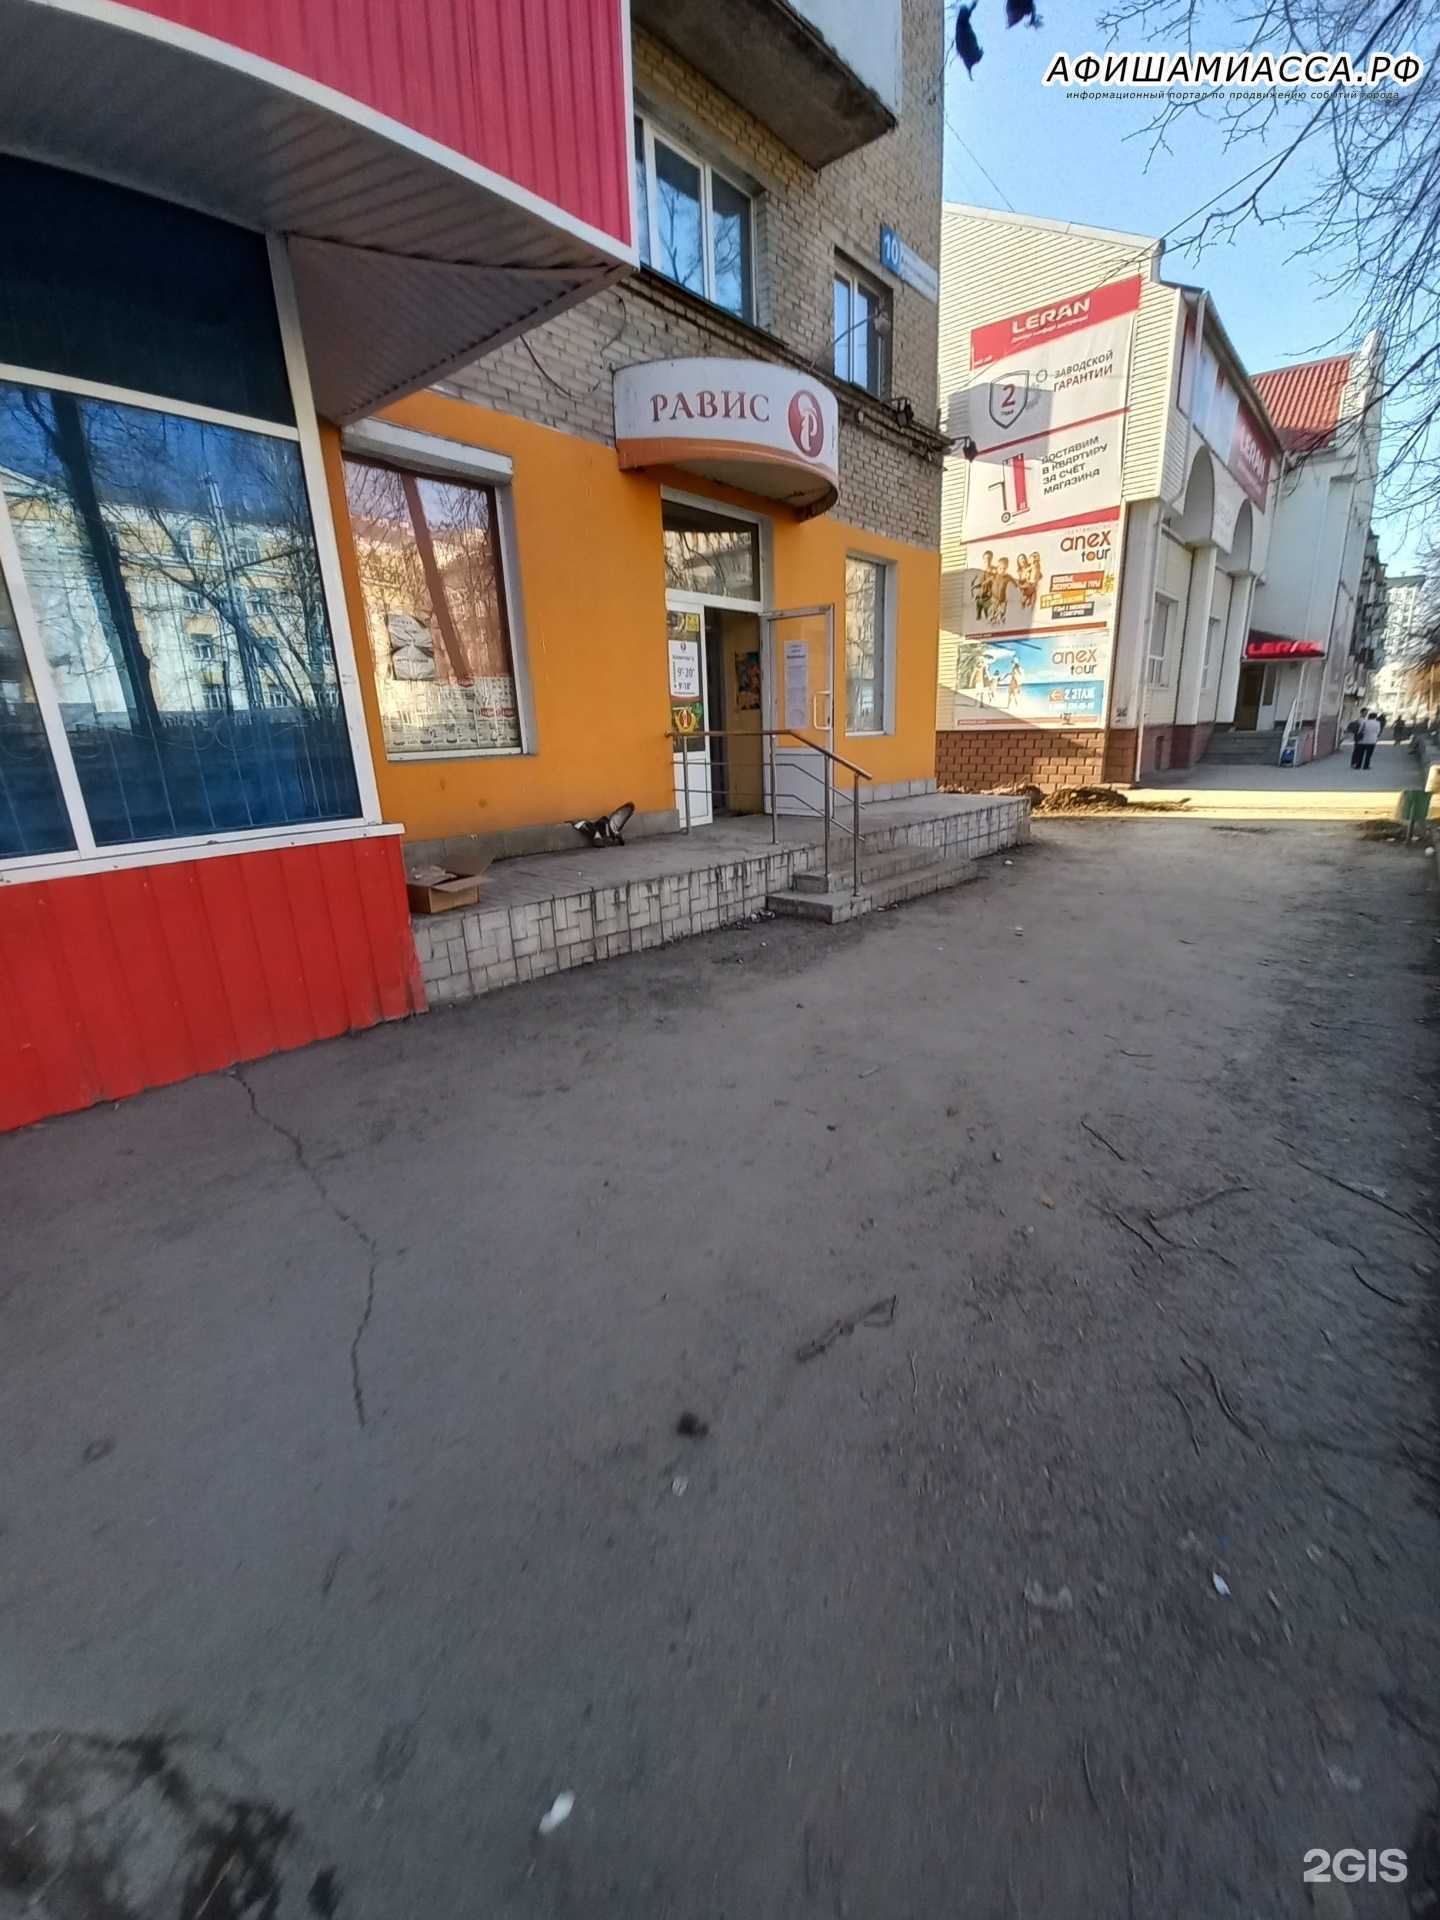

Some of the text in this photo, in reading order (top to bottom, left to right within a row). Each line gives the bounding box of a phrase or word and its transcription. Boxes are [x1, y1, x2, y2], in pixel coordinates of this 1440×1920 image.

[884, 233, 899, 265] 10
[1012, 297, 1091, 334] LERAN
[1053, 363, 1113, 392] ГАРАНТИИ
[1054, 349, 1113, 379] ЗАВОДСКОЙ
[651, 390, 770, 423] РАВИС
[1002, 383, 1016, 408] 2
[1041, 436, 1099, 464] ДОСТАВИМ
[1042, 443, 1108, 475] В КВАРТИРУ
[1043, 474, 1057, 485] ЗА
[1044, 468, 1100, 495] МАГАЗИНА
[1060, 530, 1111, 552] anex
[1081, 548, 1111, 562] tour
[1052, 648, 1097, 664] anex
[1070, 664, 1097, 675] tour
